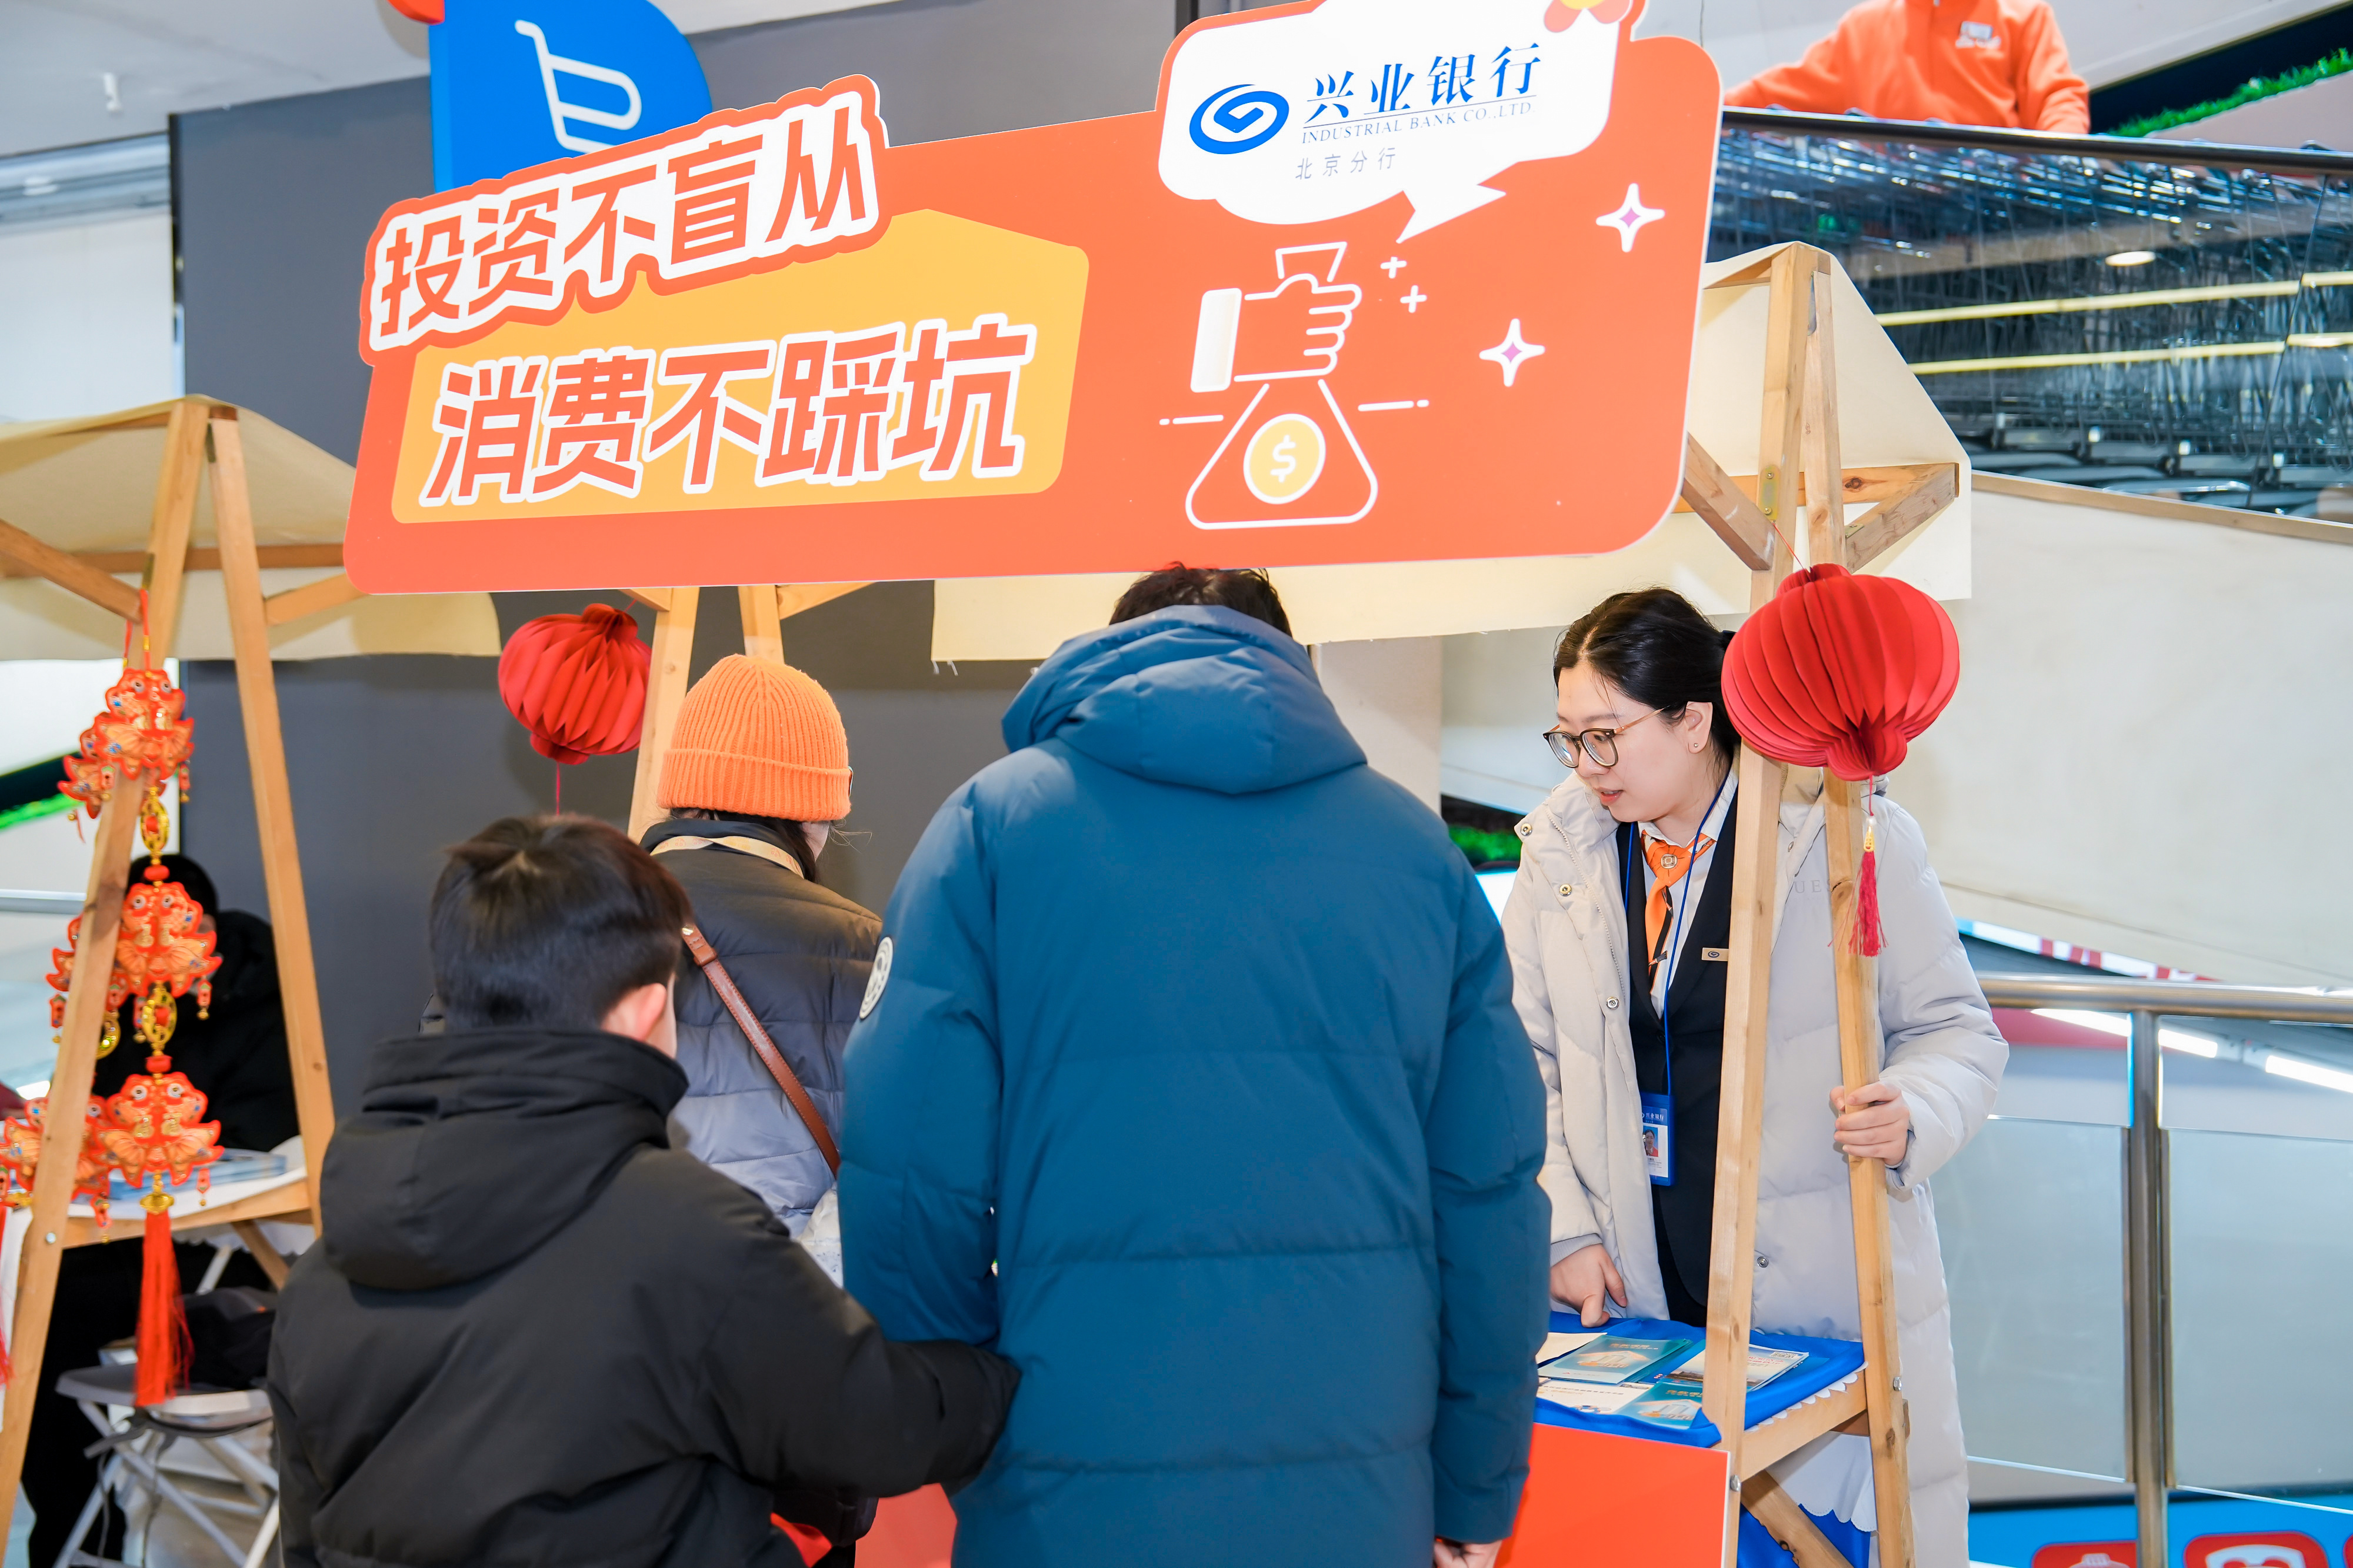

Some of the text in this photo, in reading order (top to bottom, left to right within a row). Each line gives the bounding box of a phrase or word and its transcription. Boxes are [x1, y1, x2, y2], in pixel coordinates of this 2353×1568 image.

[1304, 42, 1541, 118] 兴业银行
[1295, 147, 1397, 180] 北京分行
[1302, 119, 1402, 144] INDUSTRIAL
[1409, 111, 1457, 129] BANK
[380, 107, 866, 338] 投资不盲从
[425, 323, 1029, 499] 消费不踩坑
